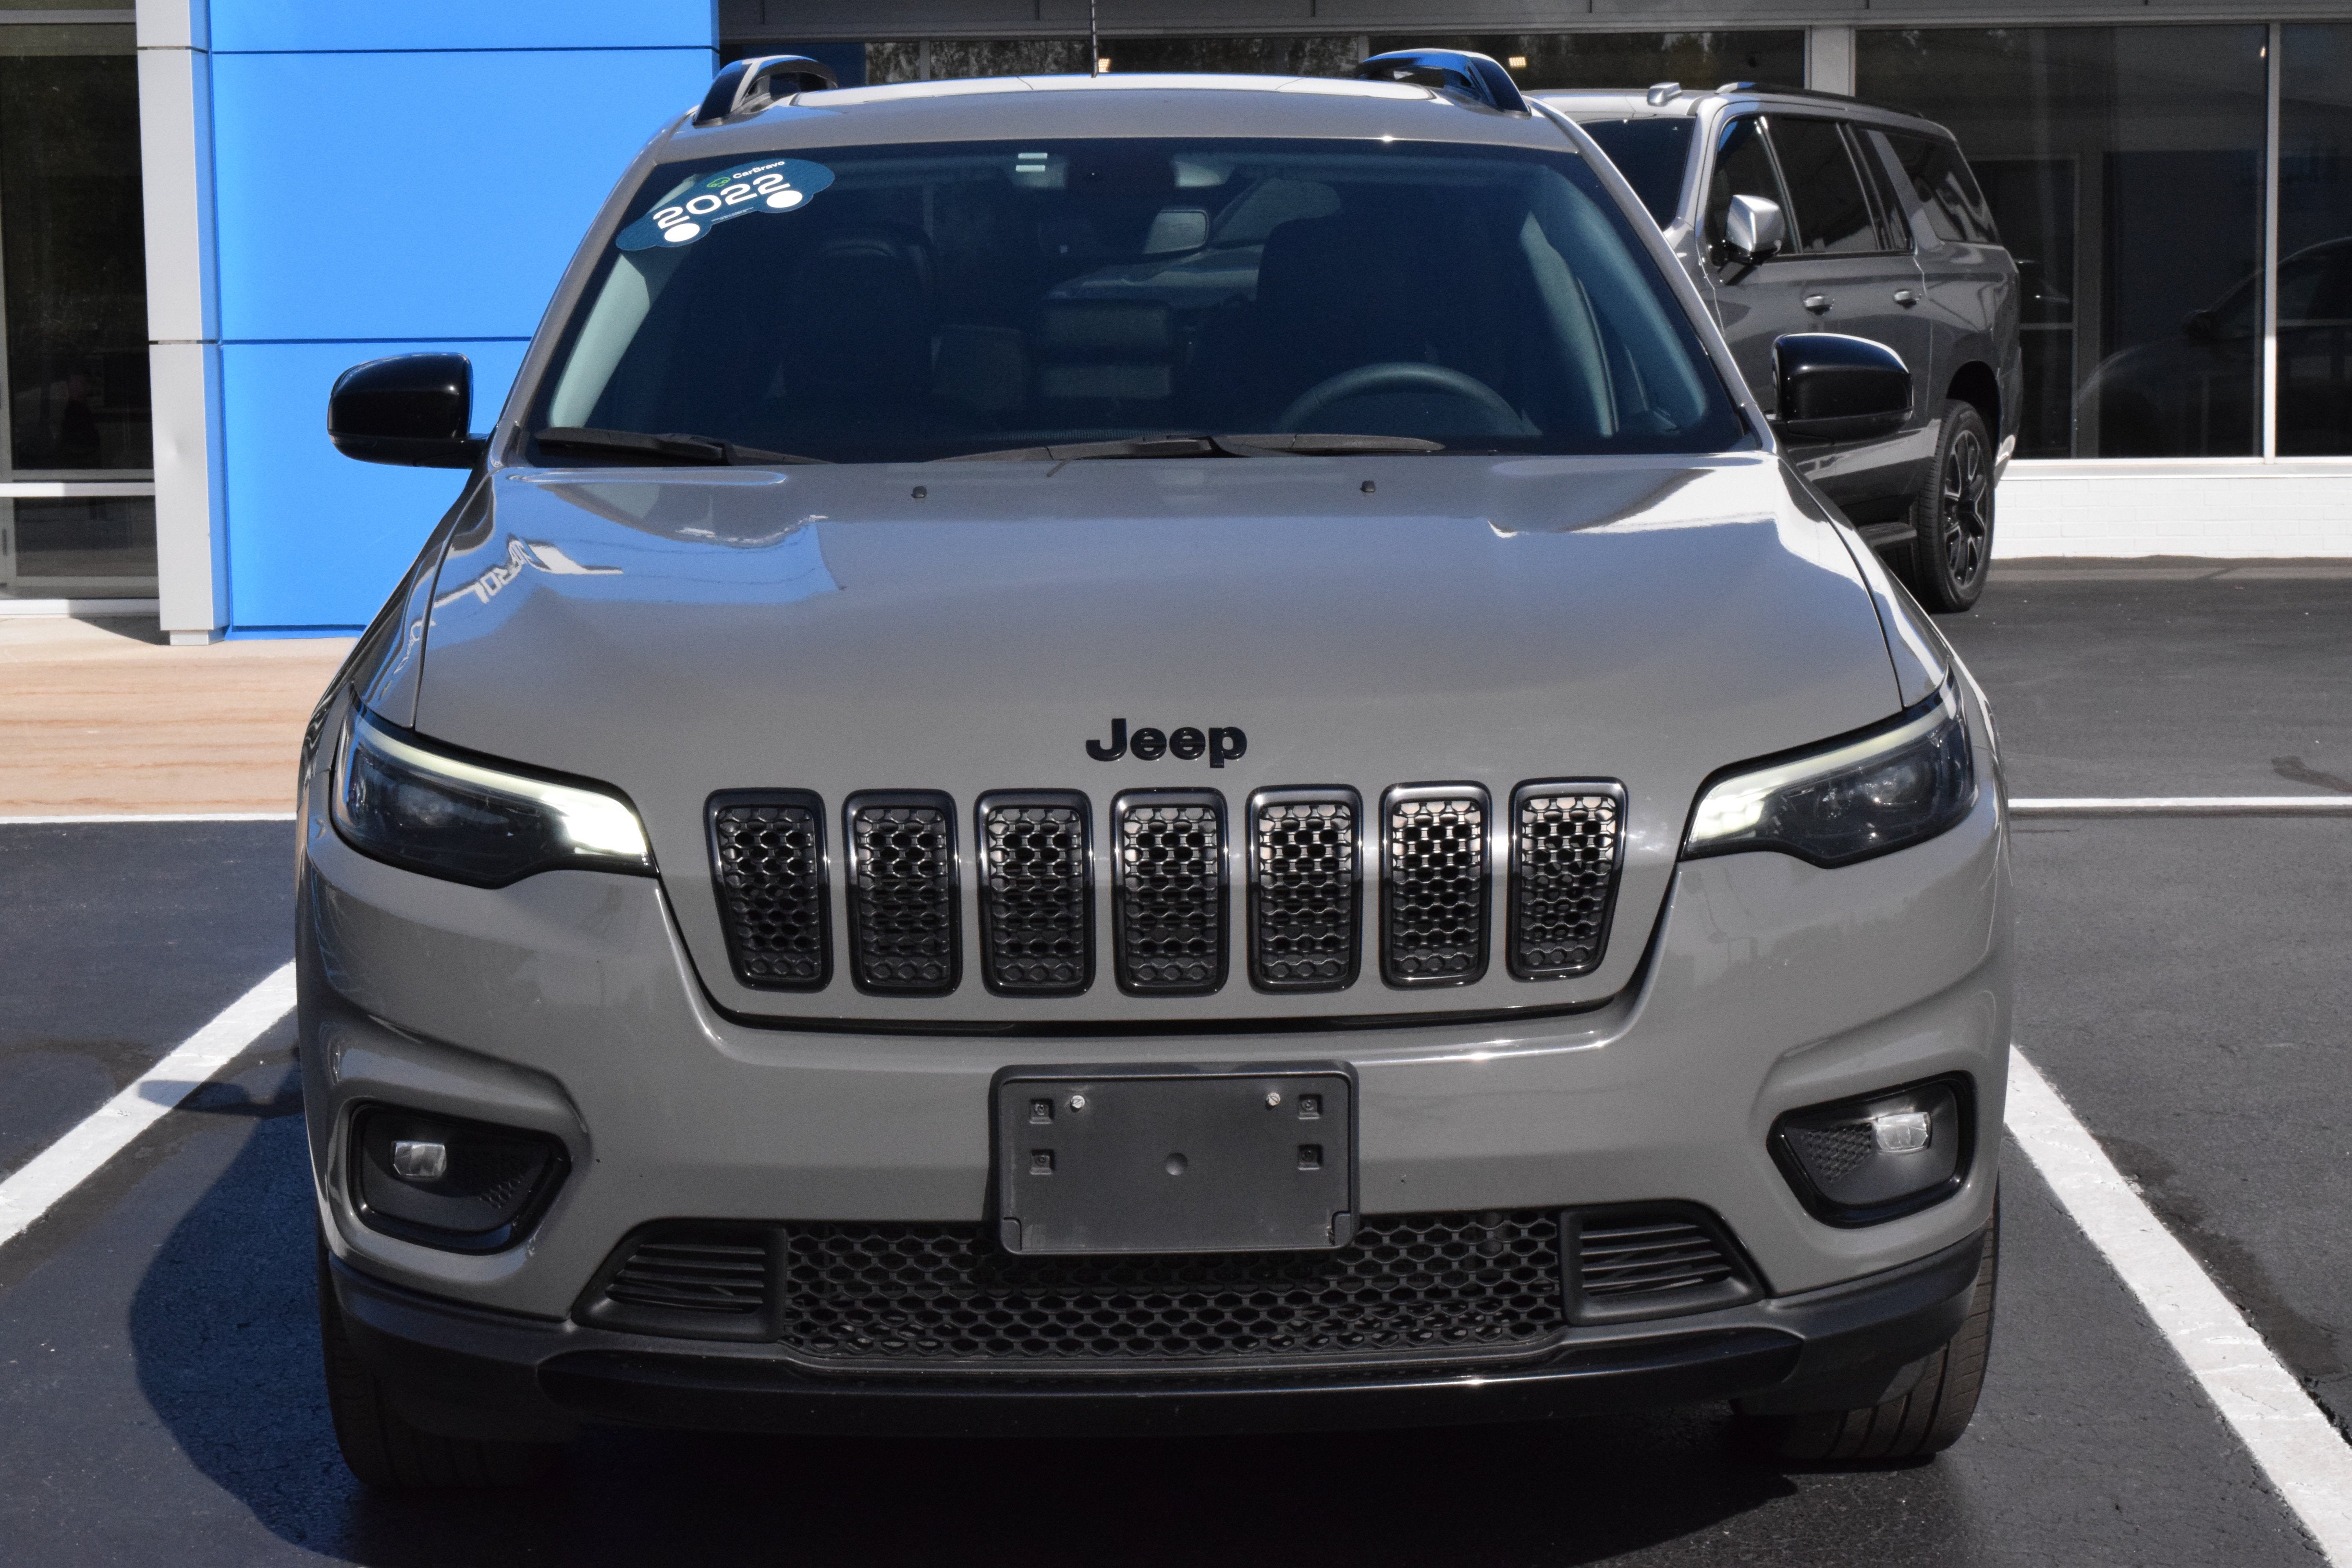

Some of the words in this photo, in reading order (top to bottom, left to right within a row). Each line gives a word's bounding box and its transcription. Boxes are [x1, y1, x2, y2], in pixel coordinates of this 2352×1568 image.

[733, 161, 785, 179] CarBravo
[653, 174, 791, 229] 2022
[1085, 718, 1247, 768] Jeep
